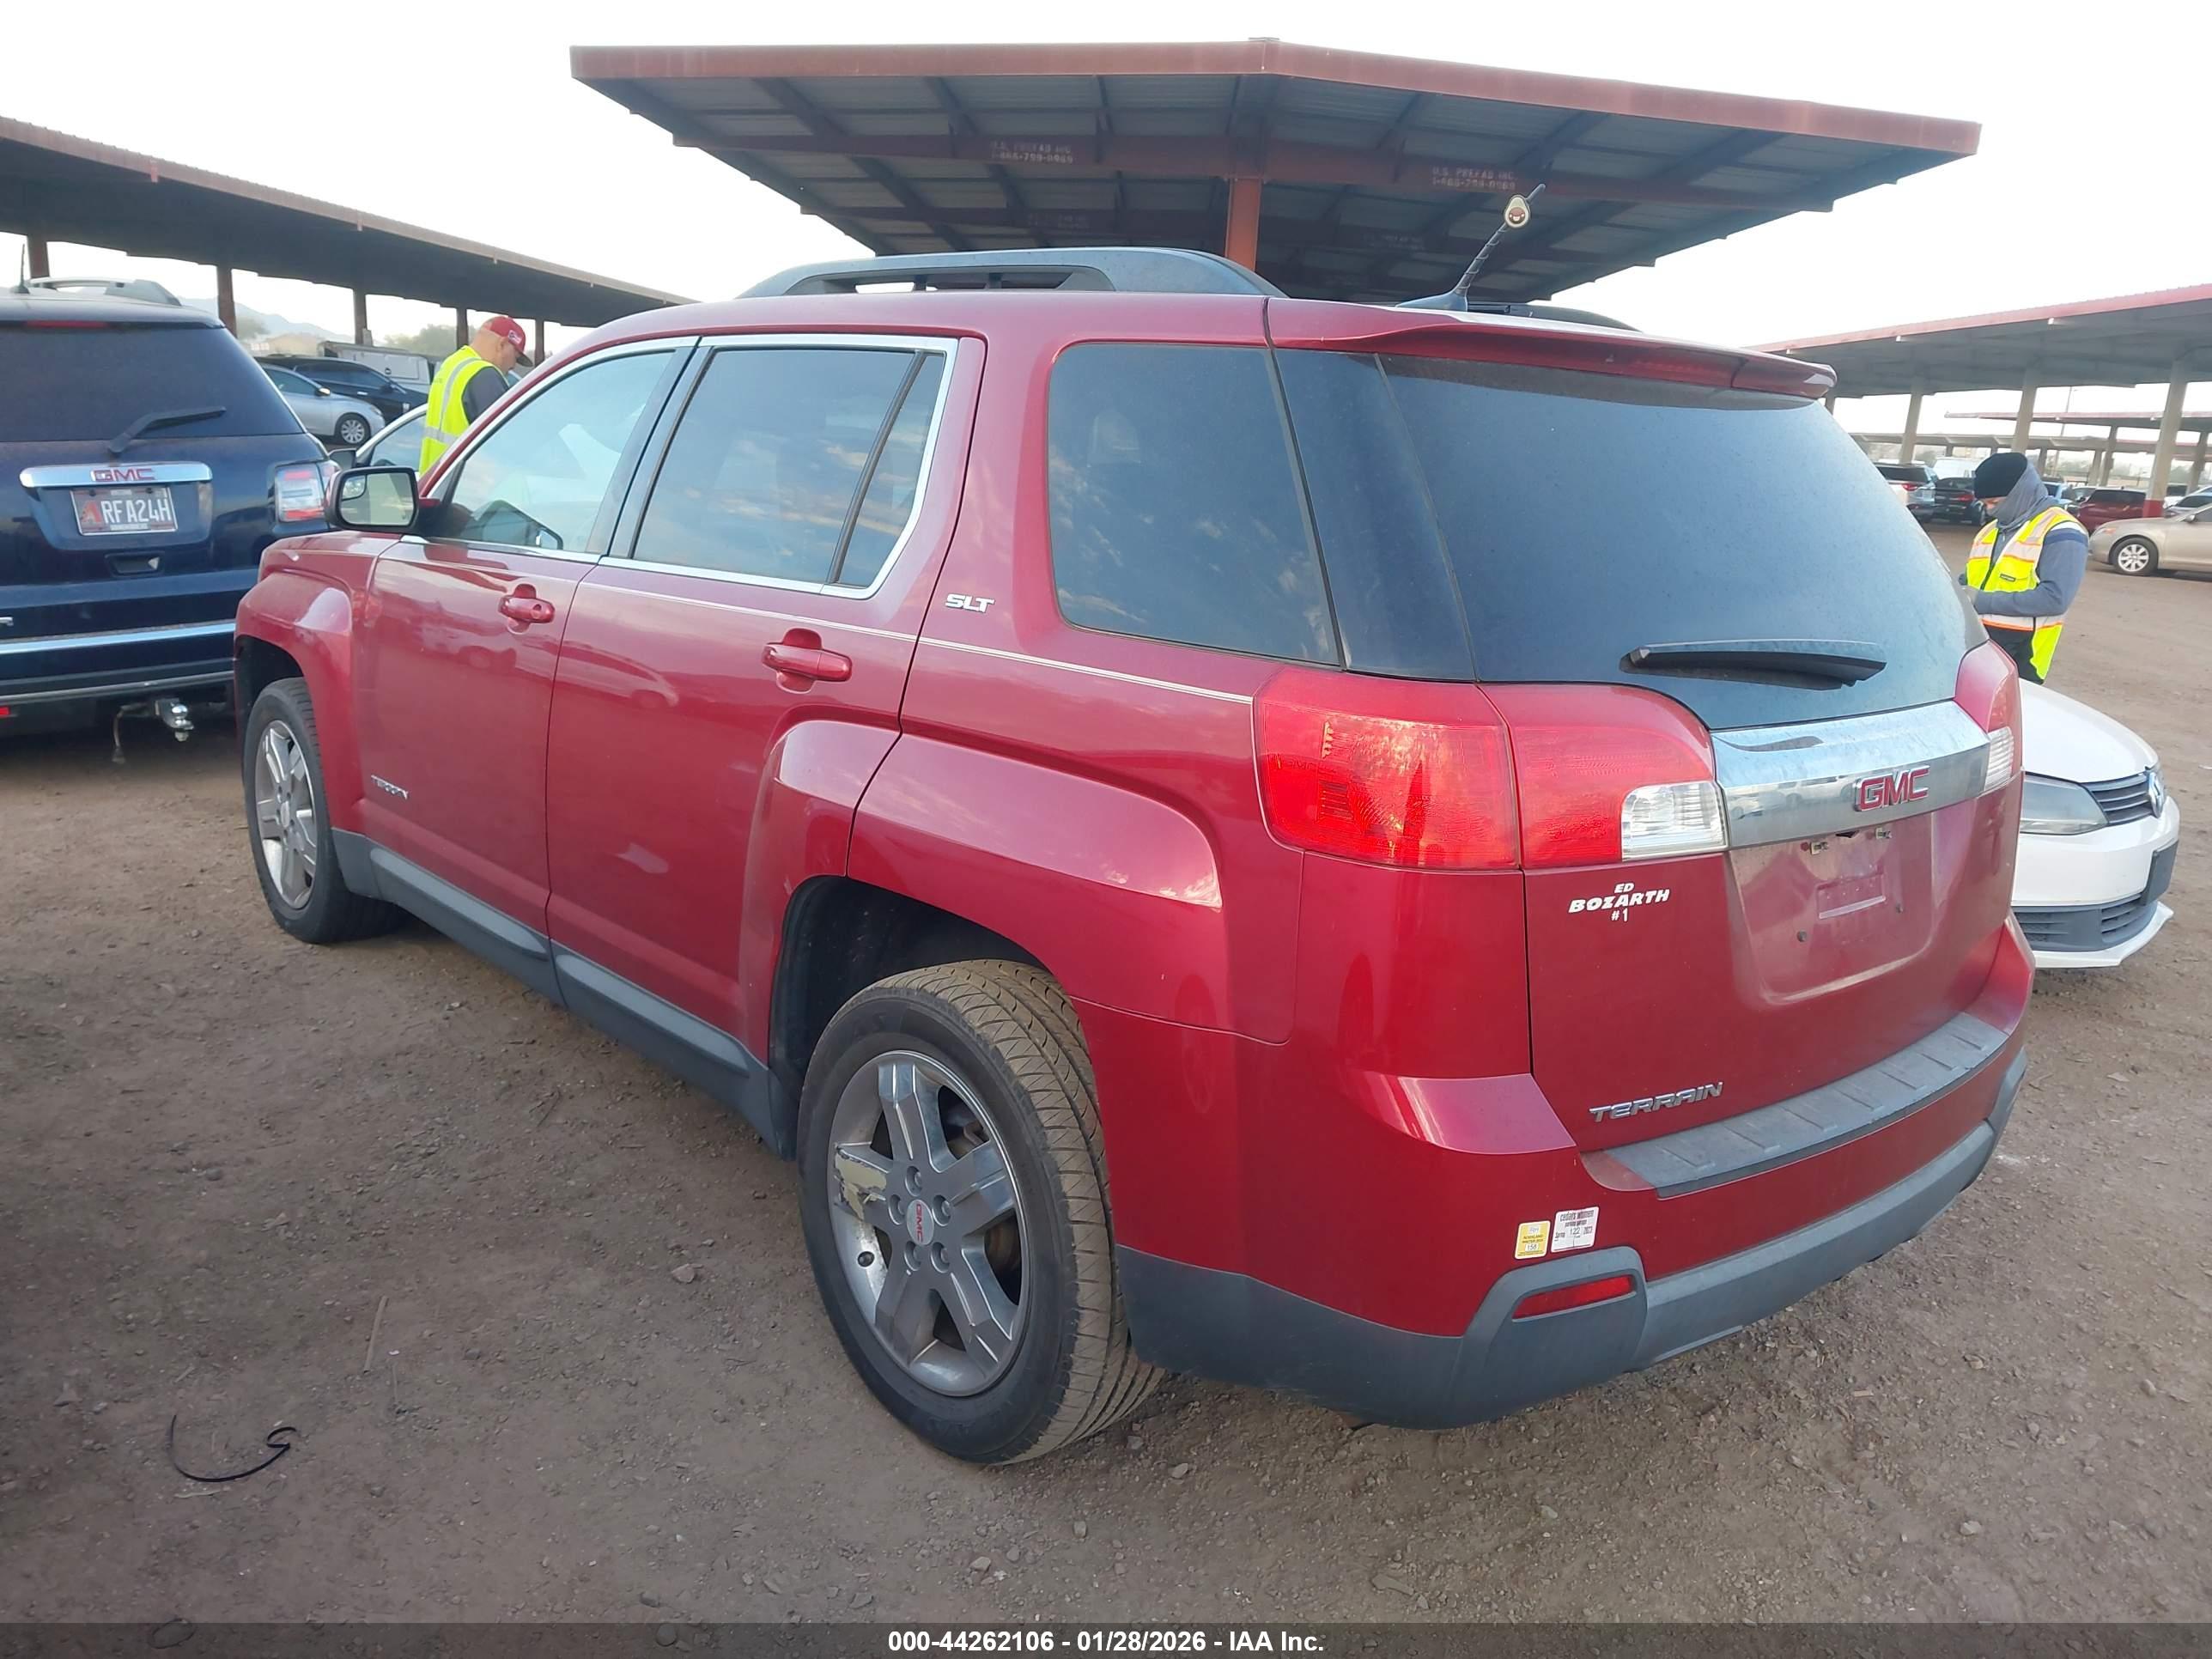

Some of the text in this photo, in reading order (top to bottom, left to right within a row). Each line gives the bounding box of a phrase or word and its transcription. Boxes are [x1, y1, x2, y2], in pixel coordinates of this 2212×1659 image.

[92, 468, 155, 482] GMC
[945, 593, 995, 613] SLT
[1855, 765, 1930, 811] GMC
[1614, 883, 1635, 893] ED
[1568, 889, 1670, 913] BOZARTH
[1611, 908, 1628, 922] #1
[1589, 1081, 1723, 1122] TERRAIN
